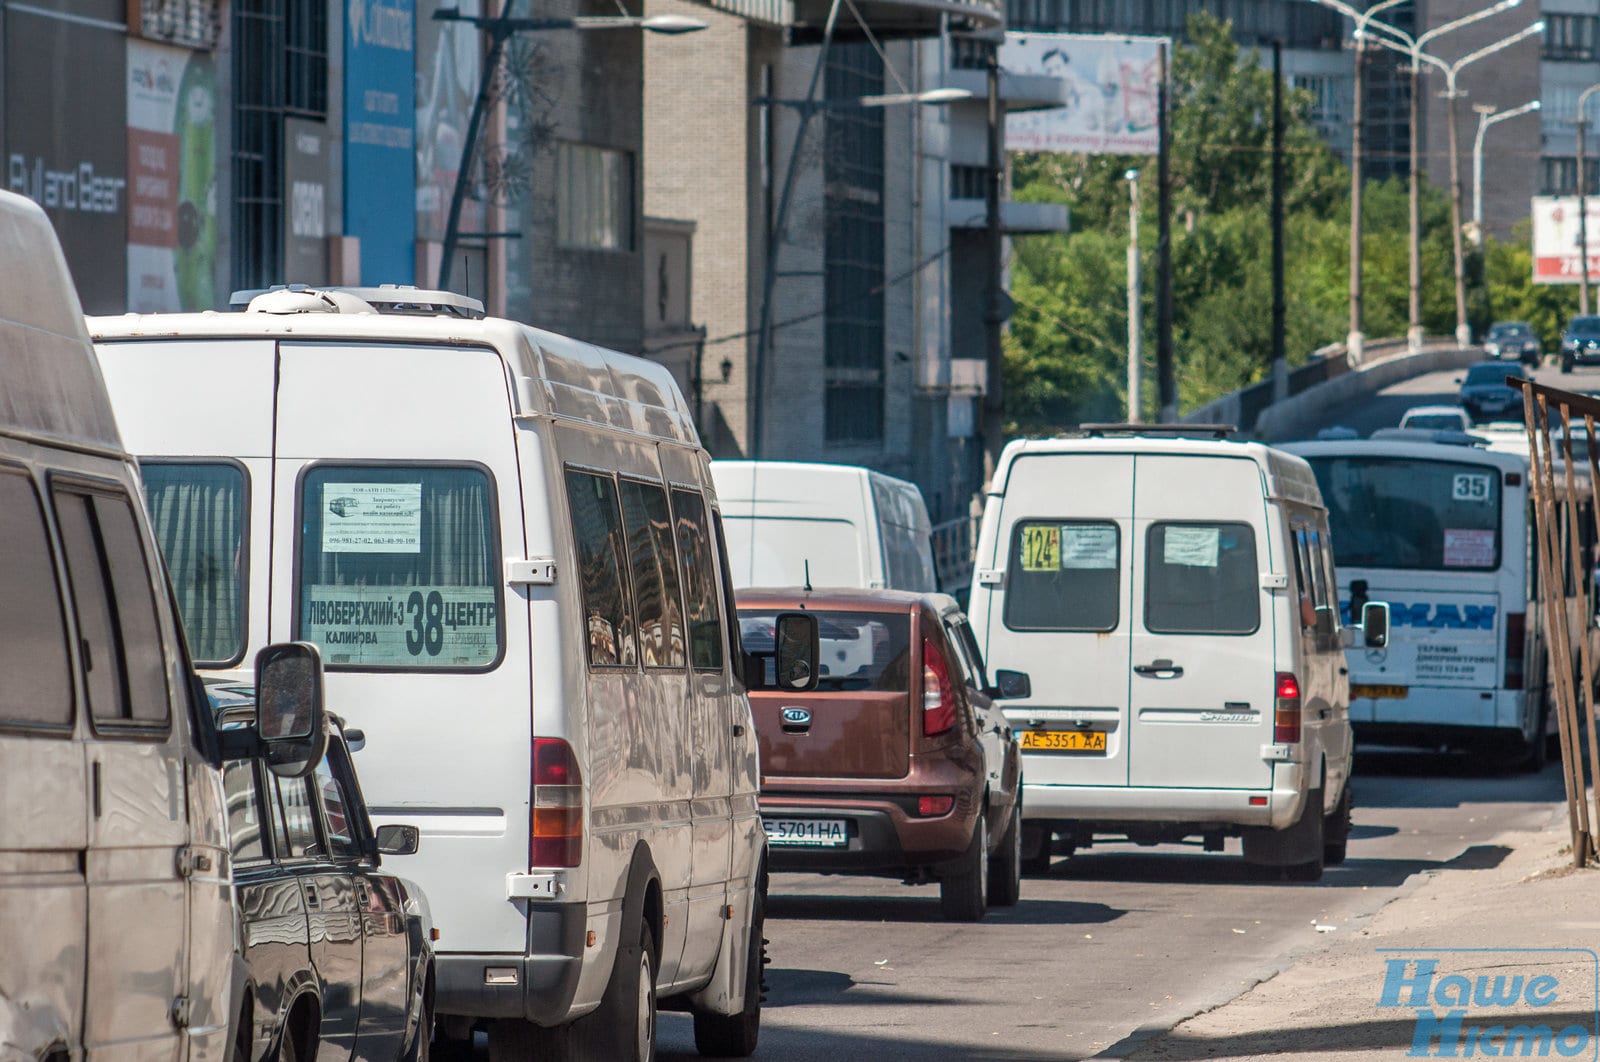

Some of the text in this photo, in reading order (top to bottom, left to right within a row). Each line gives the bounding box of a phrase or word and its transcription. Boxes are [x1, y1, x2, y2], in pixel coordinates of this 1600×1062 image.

[1456, 476, 1485, 497] 35
[406, 590, 443, 656] 38
[445, 601, 496, 630] ЦЕНТР
[325, 631, 378, 645] КАЛИНОВА
[1022, 732, 1104, 749] AE 5351 AA
[763, 821, 841, 839] E 5701 HA
